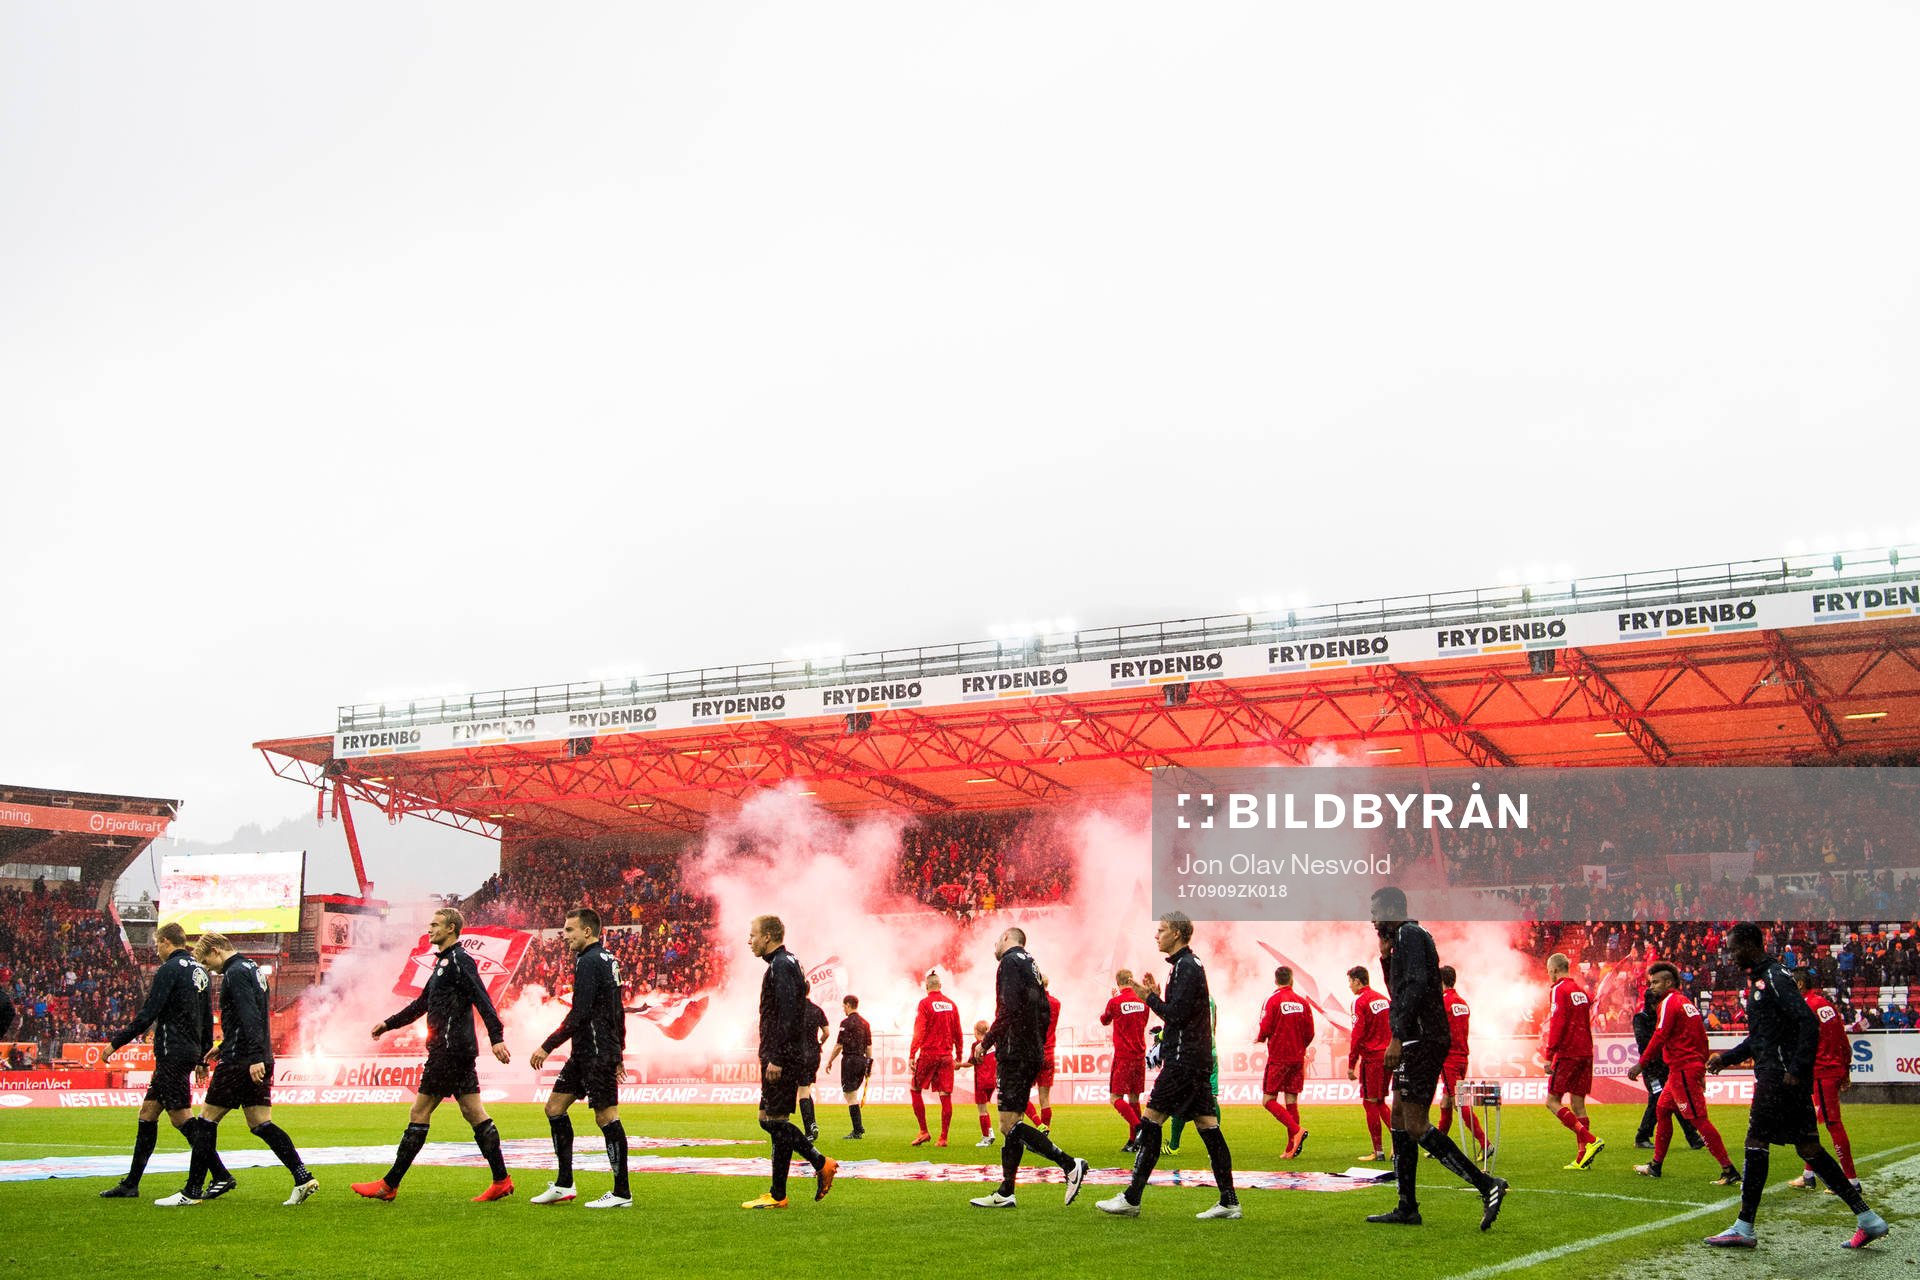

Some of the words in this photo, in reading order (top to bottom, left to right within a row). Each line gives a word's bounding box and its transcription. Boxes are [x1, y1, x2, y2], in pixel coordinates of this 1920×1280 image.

[1813, 586, 1920, 612] FRYDEN
[1619, 599, 1757, 631] FRYDENBØ
[1437, 618, 1566, 648] FRYDENBØ
[1268, 634, 1389, 664] FRYDENBØ
[1110, 652, 1223, 679] FRYDENBØ
[962, 666, 1068, 693] FRYDENBØ
[823, 681, 922, 706] FRYDENBØ
[569, 705, 657, 728] FRYDENBØ
[692, 695, 785, 717] FRYDENBØ
[343, 729, 421, 749] FRYDENBØ
[0, 809, 34, 824] nning.
[106, 817, 162, 832] Fjordkraft
[334, 1063, 425, 1087] Dekkcent
[1896, 1057, 1920, 1075] axe
[58, 1092, 107, 1108] NESTE
[271, 1089, 298, 1104] DAG
[320, 1089, 402, 1103] SEPTEMBER
[710, 1087, 763, 1102] FREDA
[1074, 1084, 1111, 1101] NES
